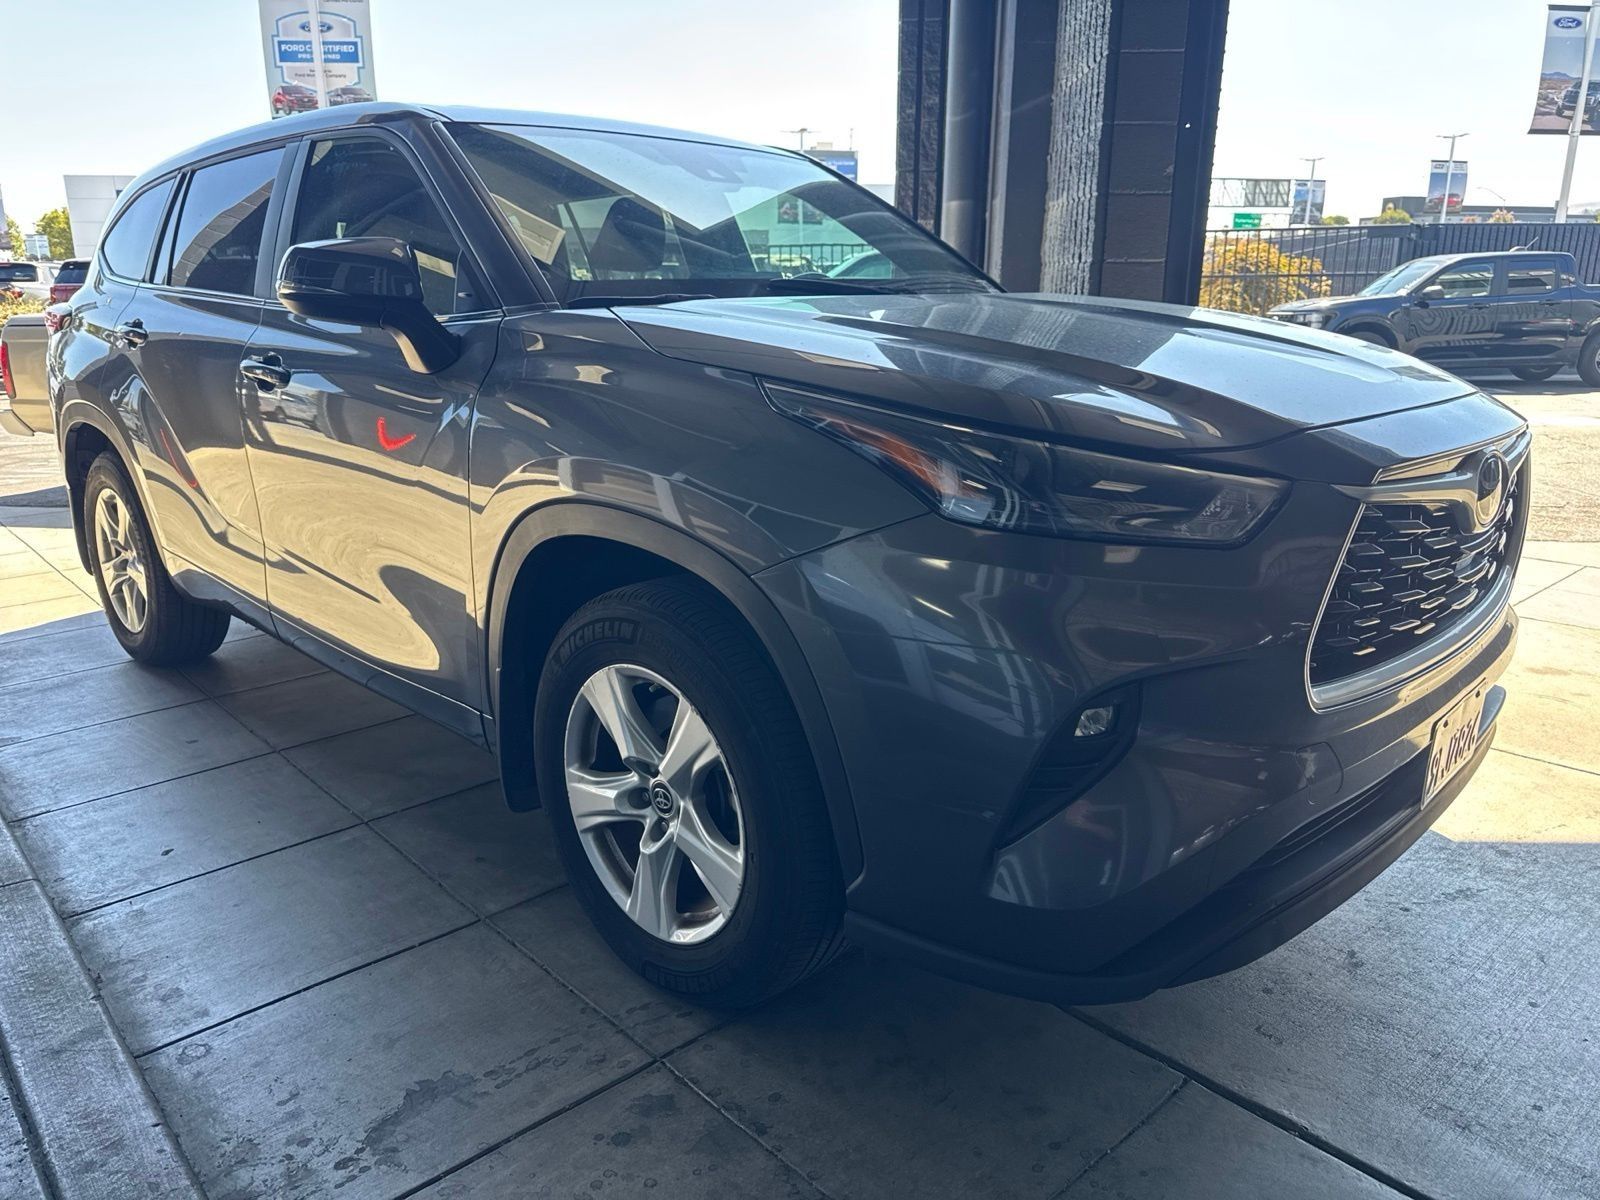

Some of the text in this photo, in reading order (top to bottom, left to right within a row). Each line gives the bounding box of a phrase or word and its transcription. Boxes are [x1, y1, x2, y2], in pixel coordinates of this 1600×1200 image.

[1558, 17, 1577, 27] Ford
[281, 44, 355, 53] FORD CRTIFIED
[556, 620, 635, 664] MICHELIN
